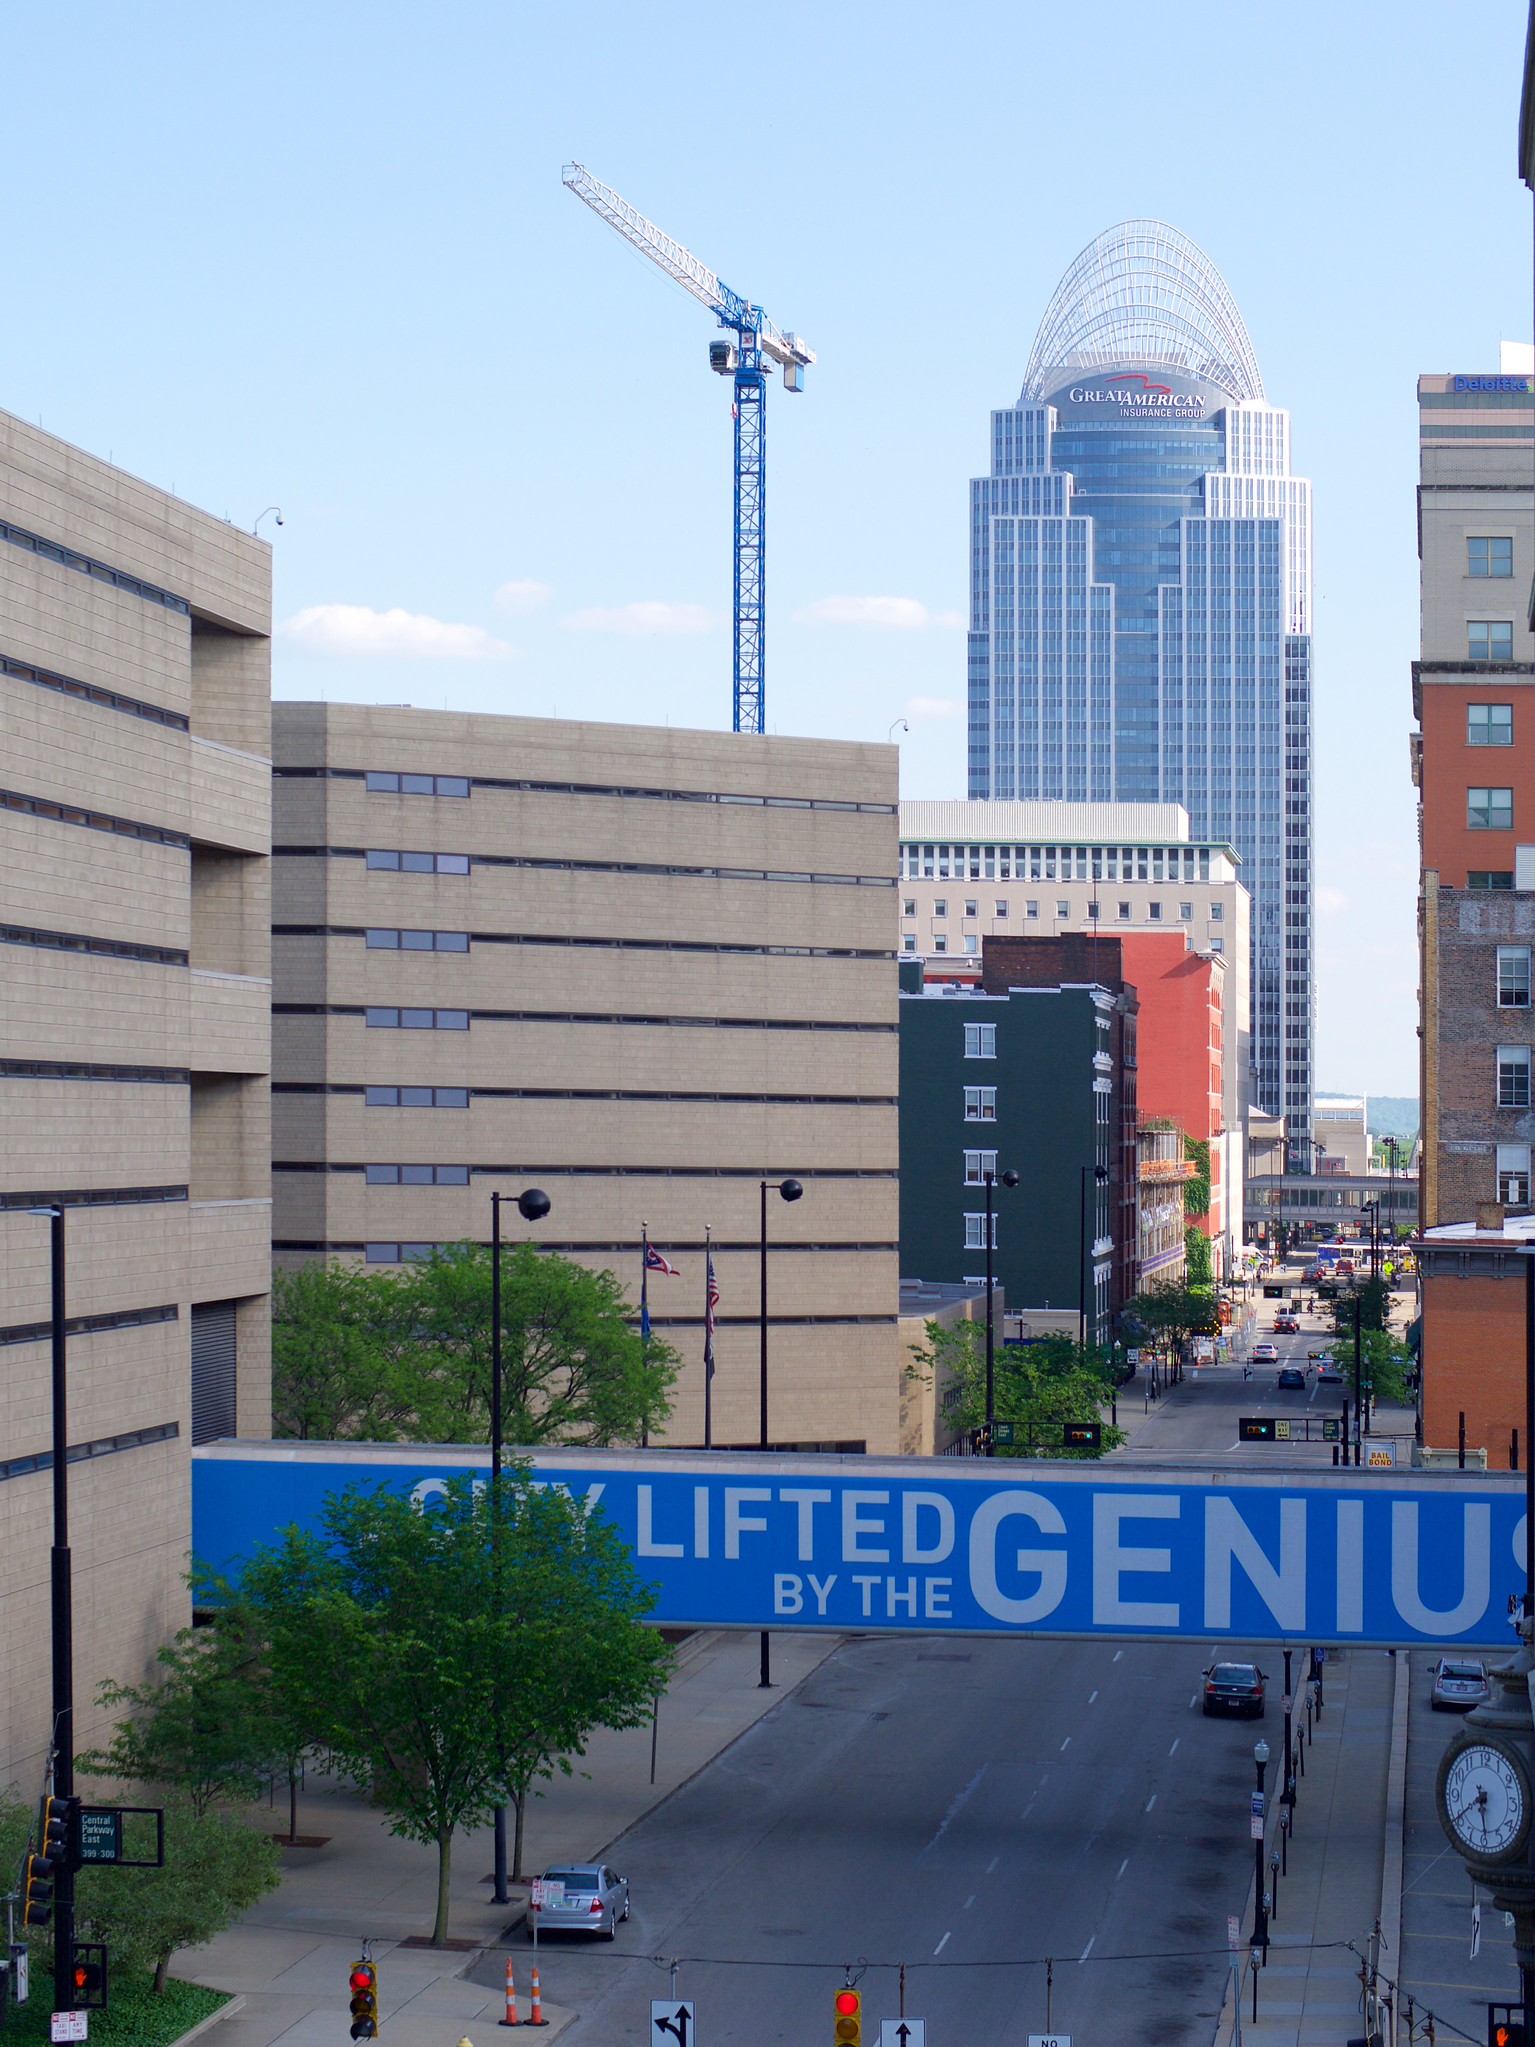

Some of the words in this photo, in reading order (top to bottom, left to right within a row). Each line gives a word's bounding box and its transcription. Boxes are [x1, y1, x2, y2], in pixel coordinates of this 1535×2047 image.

[1120, 408, 1172, 418] INSURANCE
[1175, 408, 1206, 418] GROUP
[637, 1484, 956, 1564] LIFTED
[969, 1489, 1528, 1636] GENIU
[774, 1573, 838, 1616] BY
[852, 1575, 953, 1618] THE
[1465, 1755, 1473, 1771] 11
[1480, 1753, 1491, 1767] 12
[1496, 1760, 1500, 1773] 1
[1455, 1767, 1465, 1785] 10
[1505, 1773, 1513, 1789] 2
[1451, 1788, 1460, 1803] 9
[1508, 1797, 1517, 1813] 3
[82, 1814, 111, 1824] Central
[1504, 1819, 1514, 1832] 4
[82, 1824, 115, 1836] Parkway
[1467, 1826, 1475, 1841] 7
[1495, 1829, 1503, 1844] 5
[82, 1834, 100, 1844] East
[1480, 1833, 1488, 1847] 6
